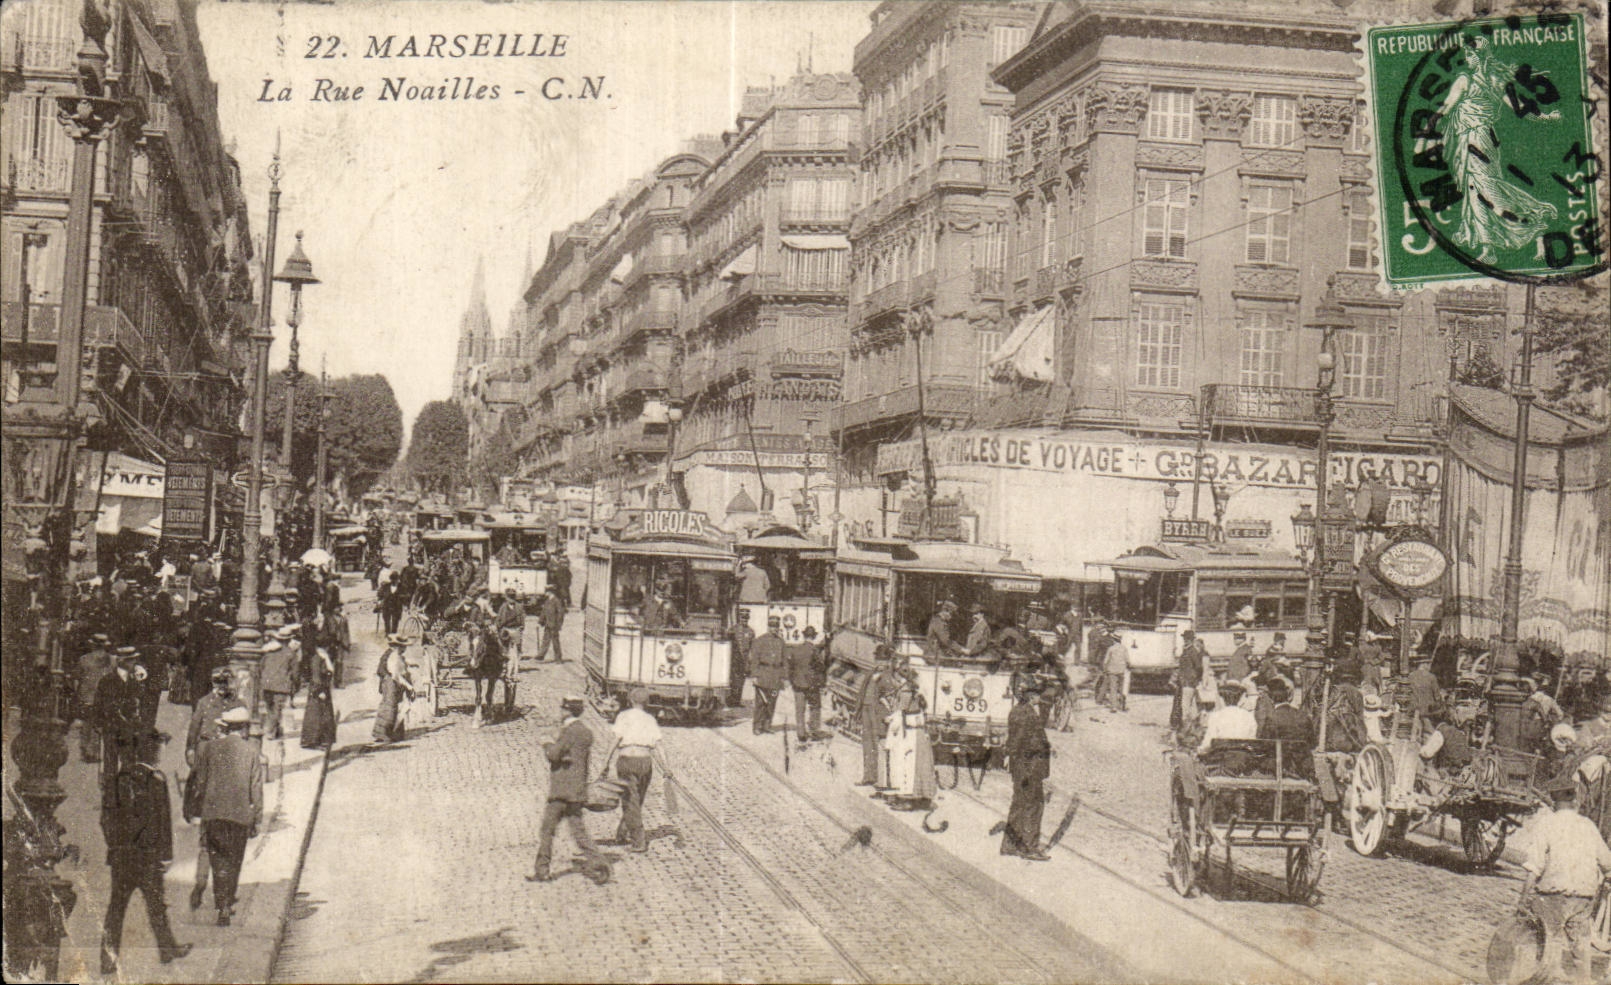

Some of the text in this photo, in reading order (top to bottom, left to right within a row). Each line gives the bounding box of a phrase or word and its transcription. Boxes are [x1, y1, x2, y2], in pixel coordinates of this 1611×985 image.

[1493, 24, 1576, 46] FRANÇAISE
[946, 436, 1001, 463] TICLES
[1006, 439, 1031, 466] DE
[1040, 442, 1123, 473] VOYAGE
[644, 510, 706, 535] RICOLES
[658, 664, 686, 679] 648
[953, 698, 988, 713] 569
